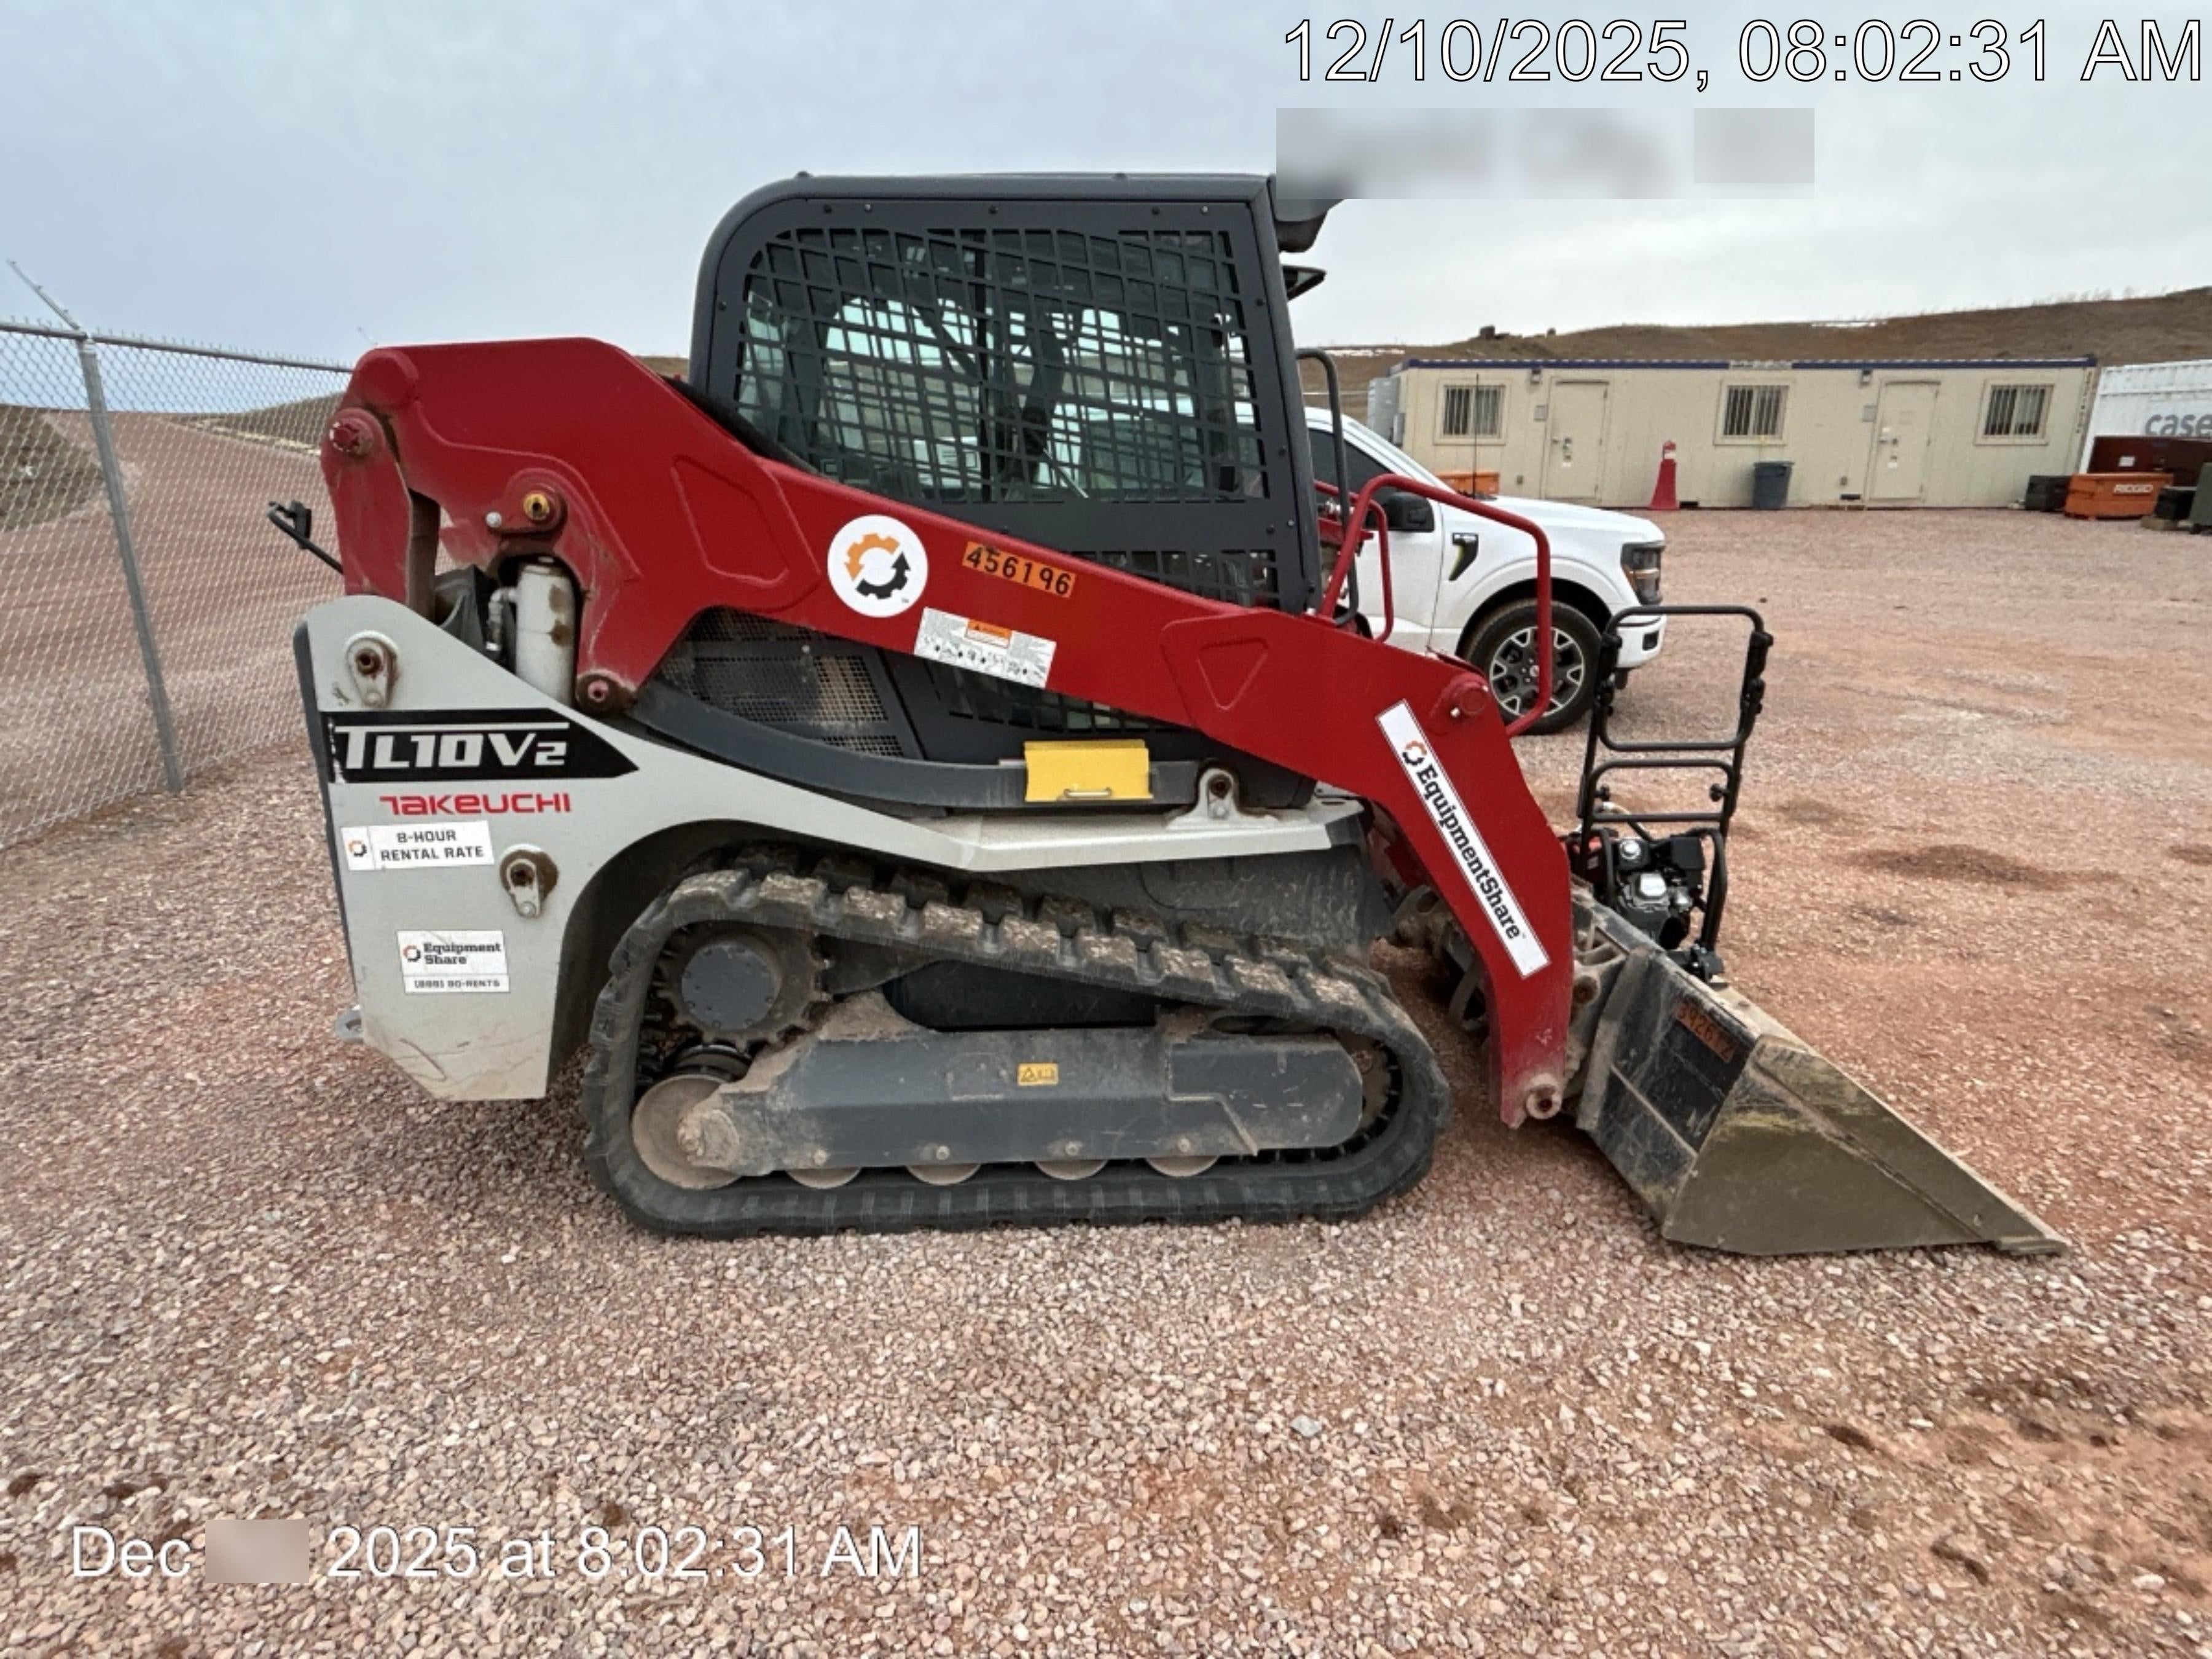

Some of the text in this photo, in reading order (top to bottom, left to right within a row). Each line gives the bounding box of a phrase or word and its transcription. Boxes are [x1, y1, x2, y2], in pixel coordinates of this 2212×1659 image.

[966, 546, 1072, 595] 456196
[335, 721, 570, 770] TL10V2
[396, 830, 457, 843] 8-HOUR
[380, 846, 484, 861] RENTAL RATE
[1416, 763, 1520, 939] EquipmentShare
[423, 942, 501, 955] Equipment
[425, 955, 466, 965] Share
